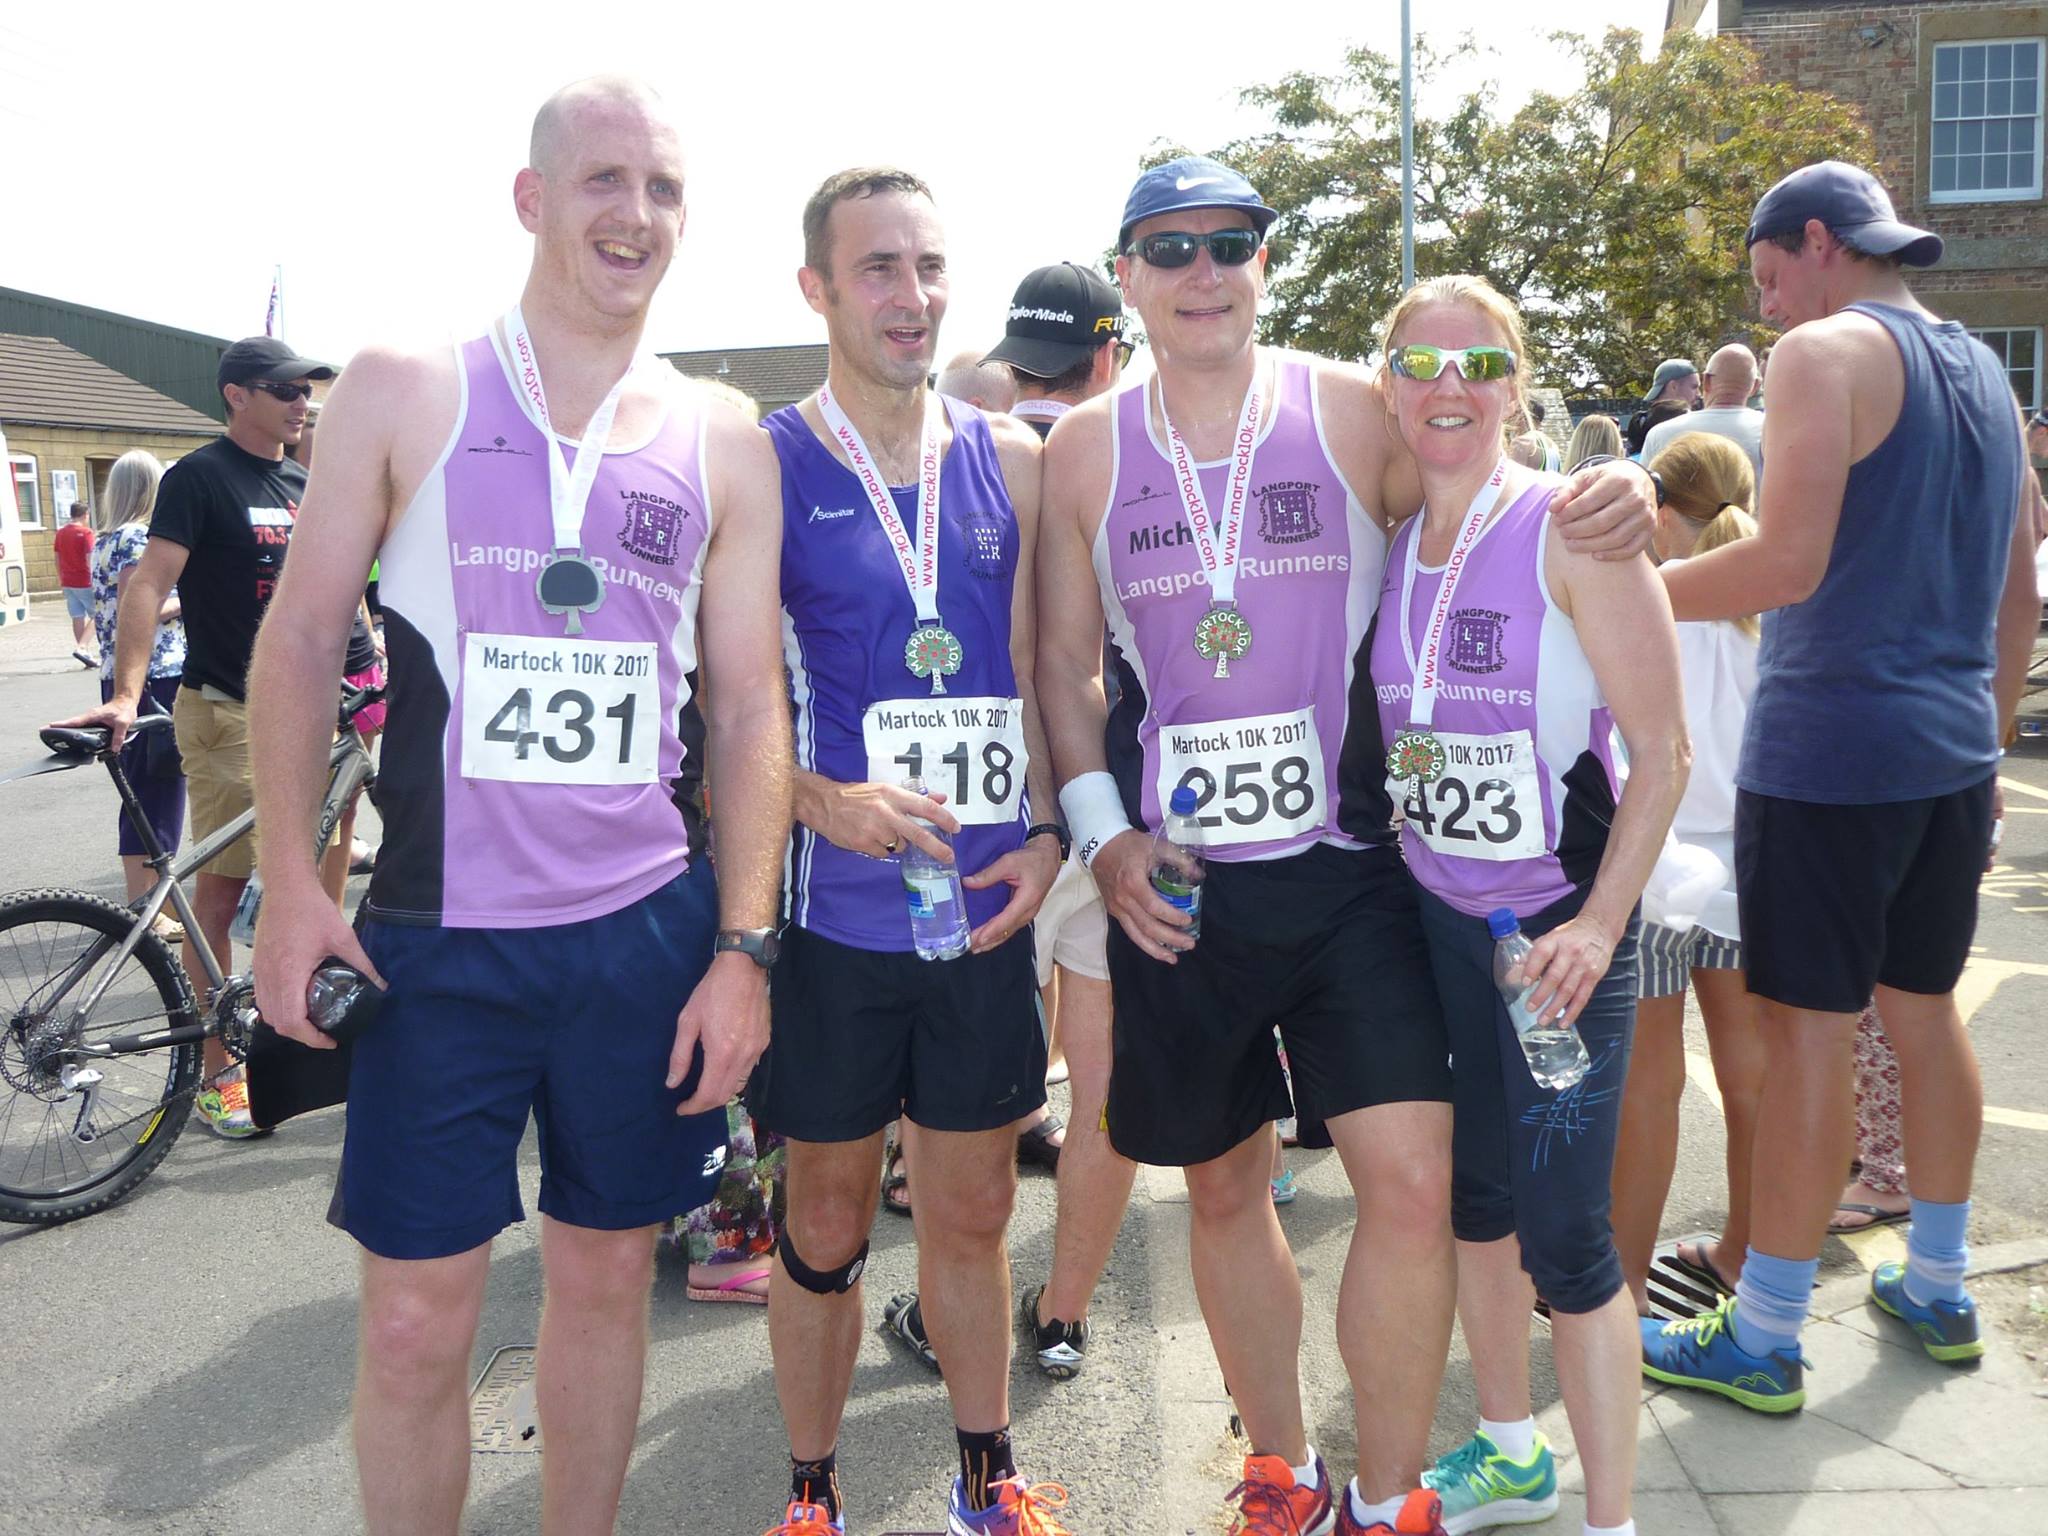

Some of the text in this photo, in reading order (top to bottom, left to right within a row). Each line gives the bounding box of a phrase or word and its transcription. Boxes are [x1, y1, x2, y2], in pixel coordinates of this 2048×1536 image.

[514, 331, 550, 427] ock10k.com
[1168, 418, 1217, 571] w.martock10k.com
[1223, 393, 1260, 566] www.martock10k.com
[1252, 480, 1321, 498] LANGPORT
[619, 490, 690, 519] LANGPORT
[922, 420, 942, 587] www.martock10k.co
[621, 539, 676, 566] RUNNERS
[1263, 529, 1321, 545] RUNNERS
[453, 543, 681, 607] Langpo Runners
[1116, 553, 1349, 601] Langpo Runners
[1422, 512, 1484, 689] www.martock10k.com
[1448, 608, 1511, 625] LANGPORT
[908, 629, 959, 672] MARTOCK 10K
[1198, 612, 1249, 656] MARTOCK 10K
[483, 646, 648, 677] Martock 10K 2017
[931, 667, 943, 692] 2017
[1219, 650, 1228, 675] 2017
[1448, 661, 1503, 675] RUNNERS
[1435, 681, 1533, 706] Runners
[484, 687, 638, 764] 431
[878, 709, 1008, 731] Martock 10K 2017
[1172, 720, 1307, 755] Martock 10K 2017
[894, 740, 1014, 806] 118
[1390, 735, 1443, 780] MARTOCK 10K
[1448, 743, 1513, 767] 10K 2017
[1177, 756, 1315, 828] 258
[1409, 774, 1420, 799] 2017
[1402, 777, 1522, 844] 423
